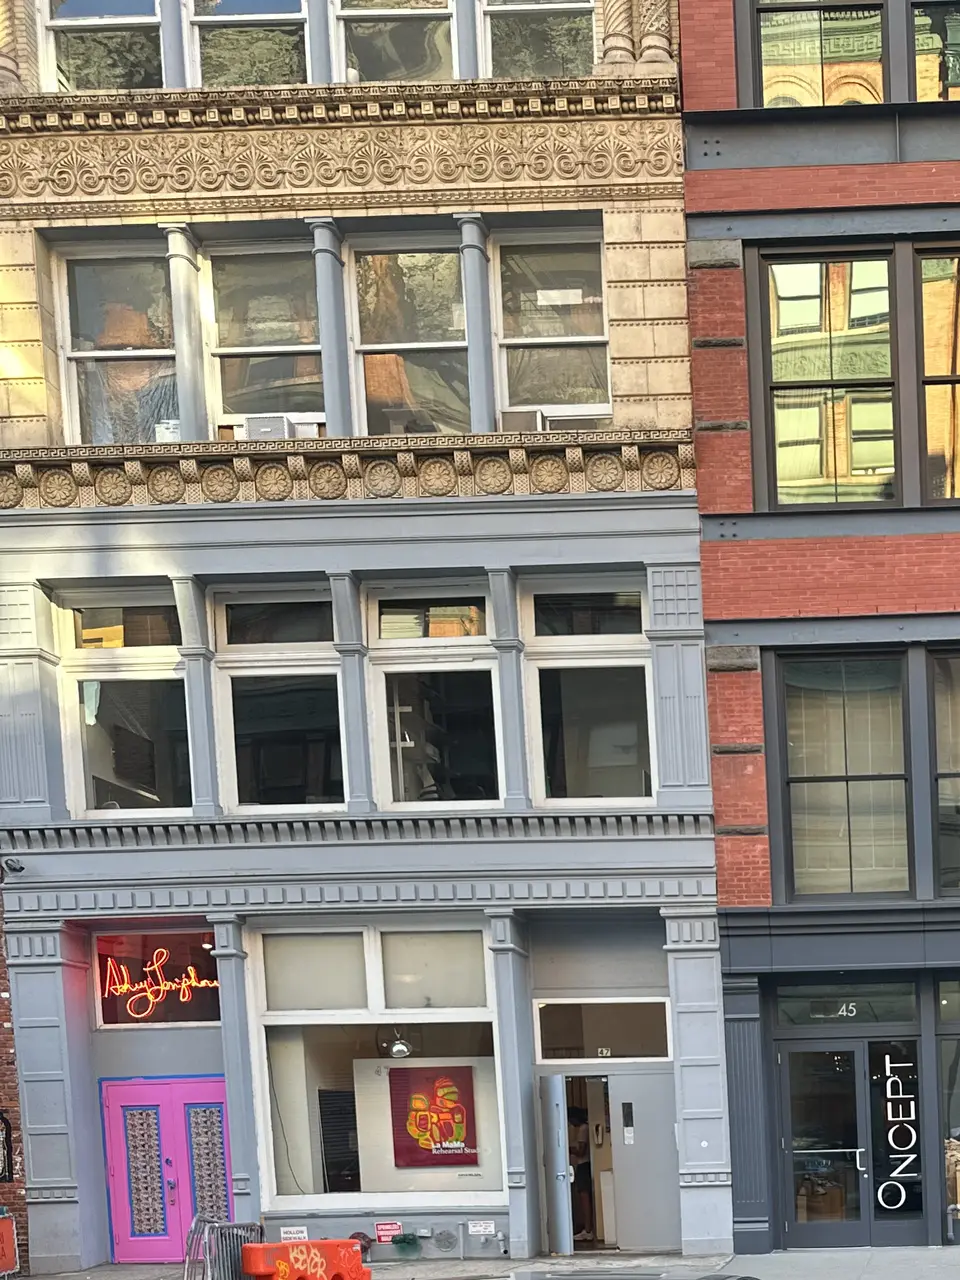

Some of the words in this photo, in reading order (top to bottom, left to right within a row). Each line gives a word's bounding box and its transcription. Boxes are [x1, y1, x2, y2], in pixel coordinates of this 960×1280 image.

[837, 1003, 857, 1017] 45
[599, 1048, 610, 1056] 47
[877, 1054, 917, 1209] ONCEPT
